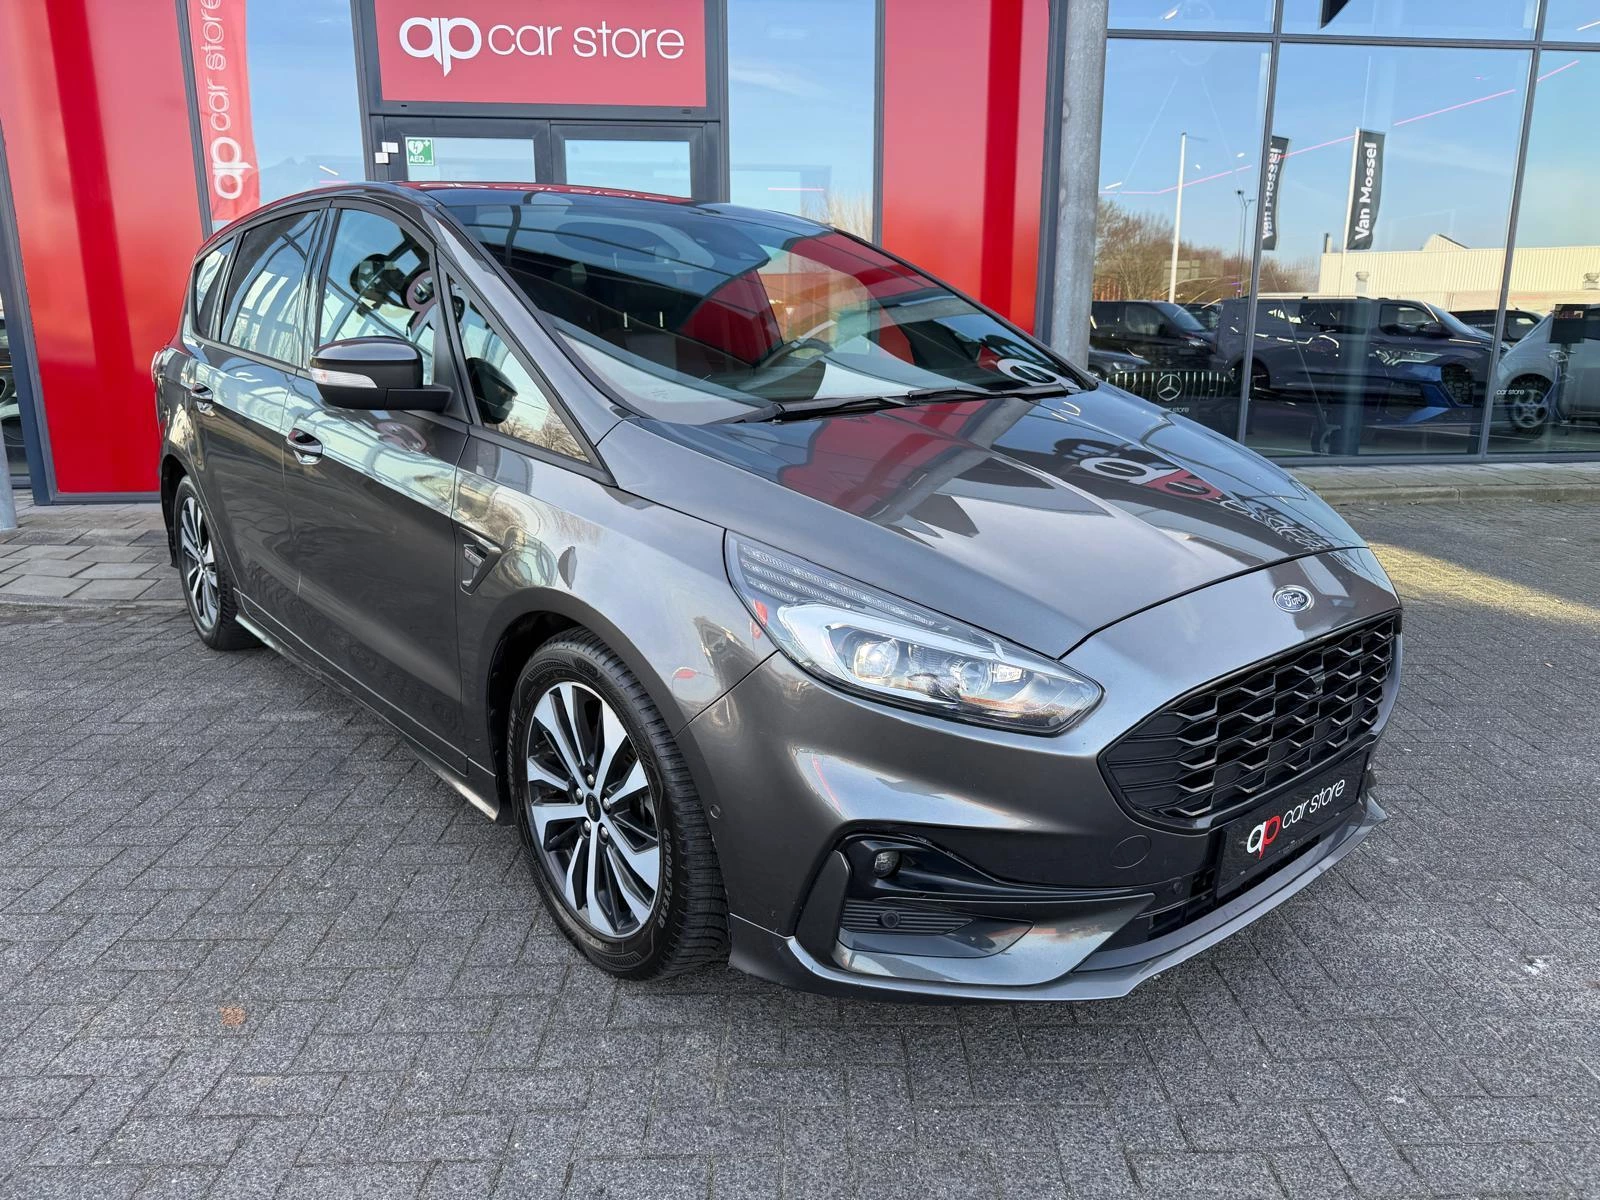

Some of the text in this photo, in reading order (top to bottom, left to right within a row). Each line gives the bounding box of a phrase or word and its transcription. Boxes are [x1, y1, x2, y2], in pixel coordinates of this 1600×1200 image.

[399, 17, 685, 77] ap car store
[207, 76, 231, 131] car
[409, 155, 425, 163] AED
[1354, 142, 1377, 240] Van Mossel
[1246, 815, 1281, 860] ap
[1282, 799, 1310, 829] car
[1309, 779, 1346, 814] store
